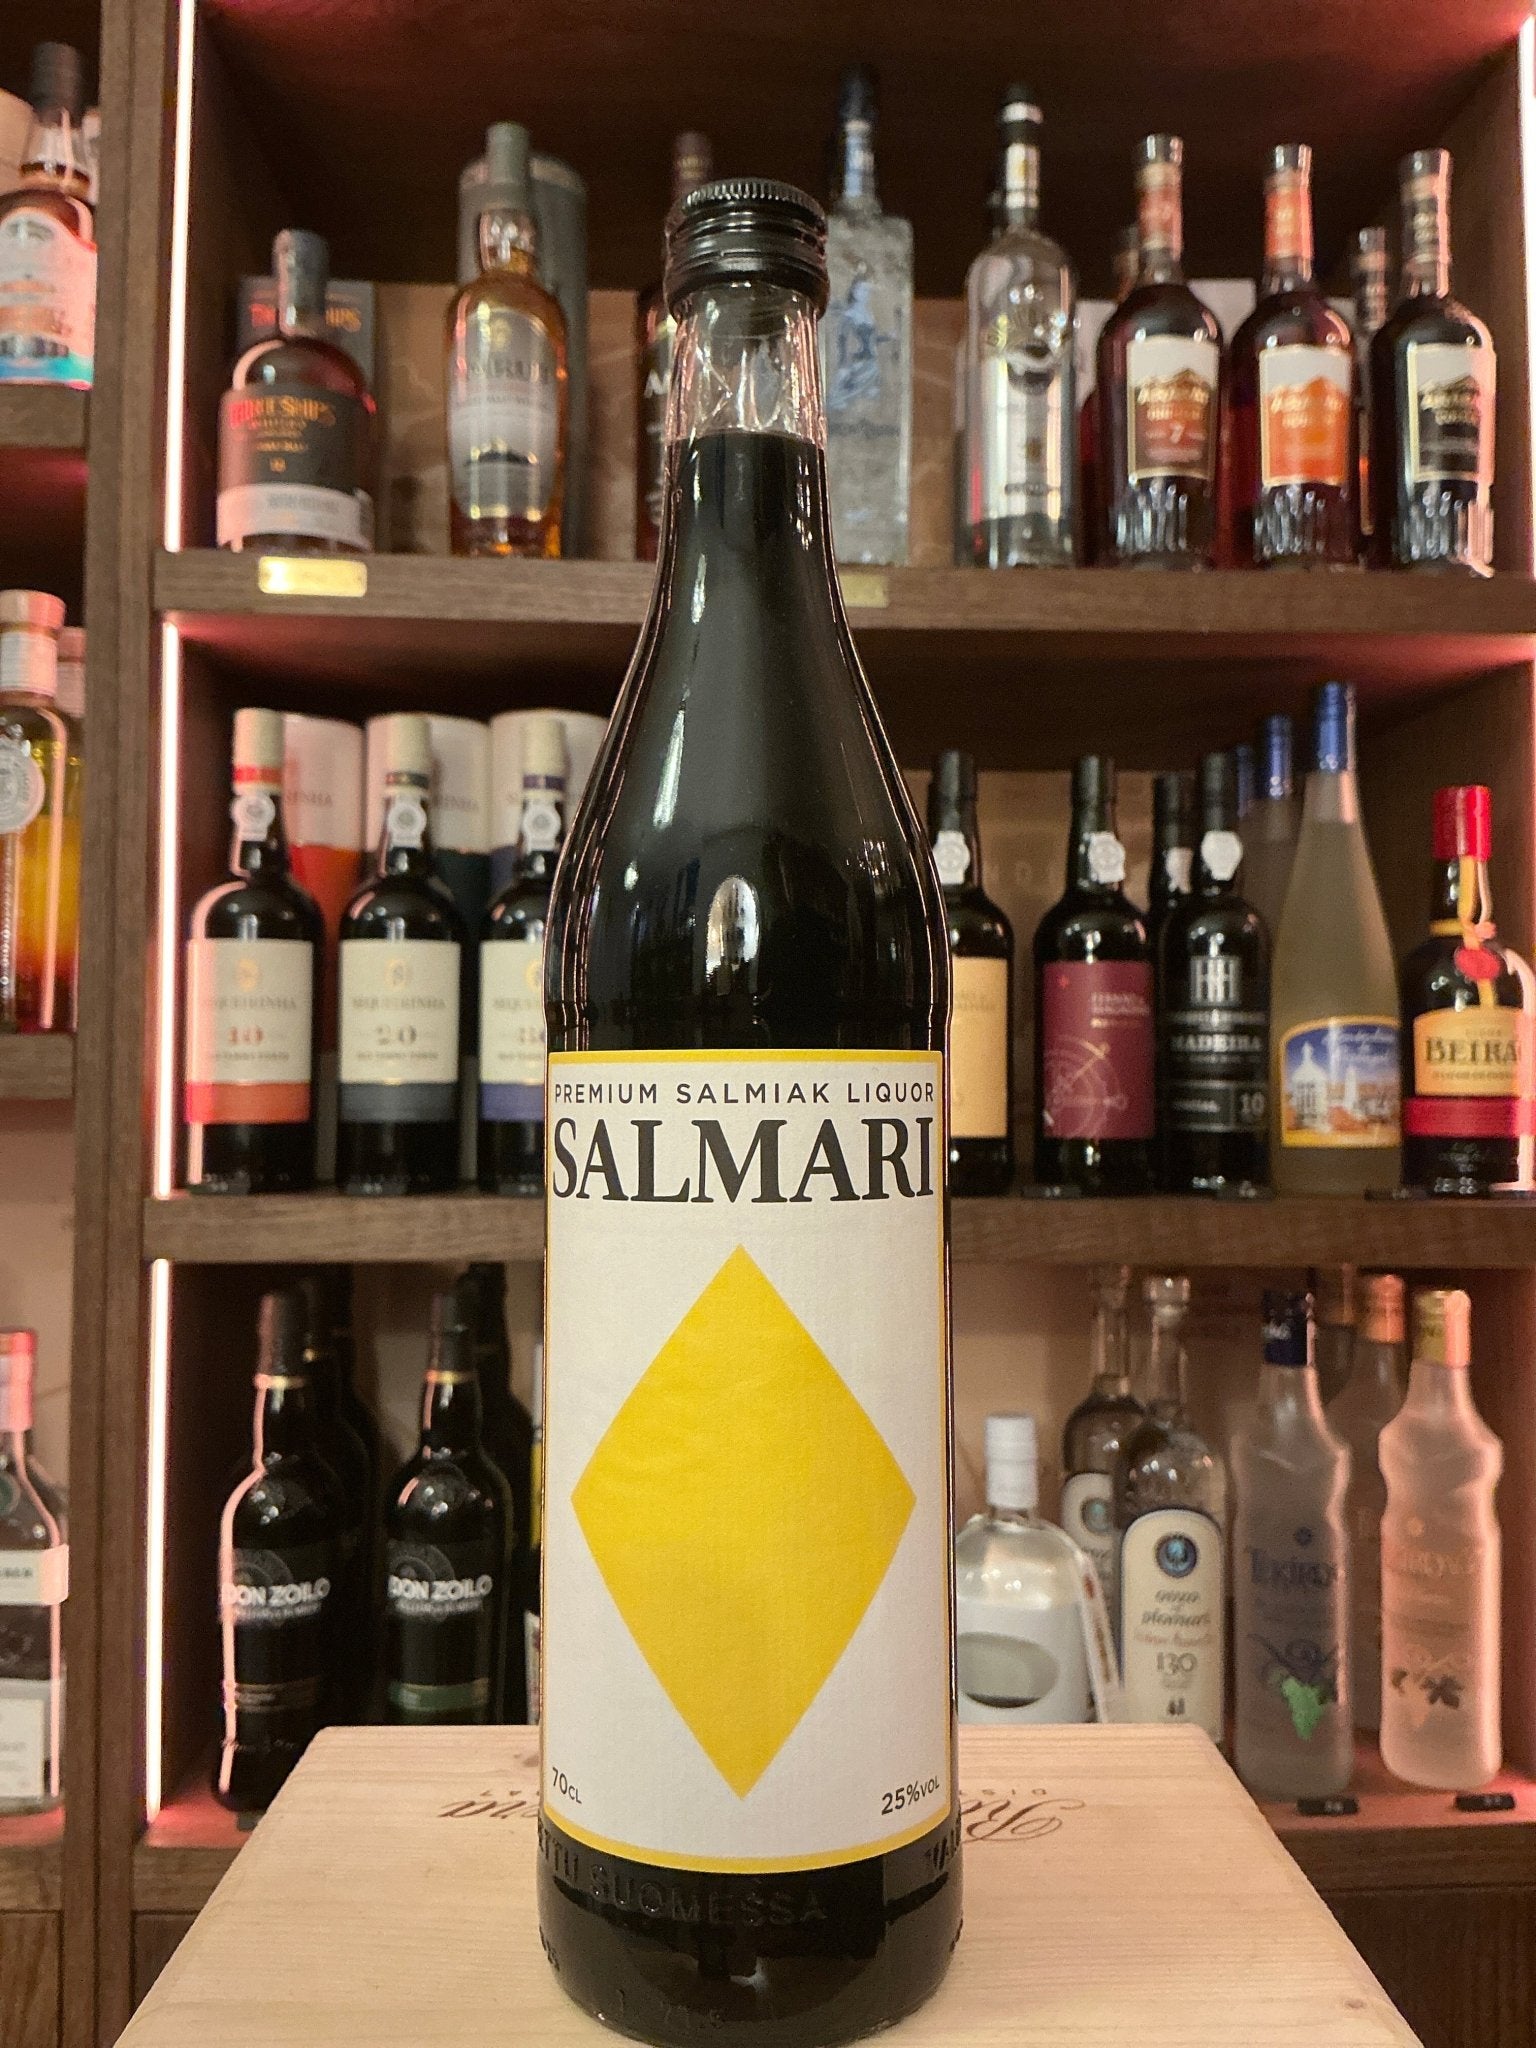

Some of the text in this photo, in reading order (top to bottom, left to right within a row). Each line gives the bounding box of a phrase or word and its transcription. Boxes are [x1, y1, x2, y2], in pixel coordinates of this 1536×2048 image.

[554, 1081, 934, 1104] PREMIUM SALMIAK LIQUOR
[552, 1116, 934, 1204] SALMARI
[268, 1577, 331, 1608] ZOILO
[387, 1574, 494, 1603] DON ZOILO
